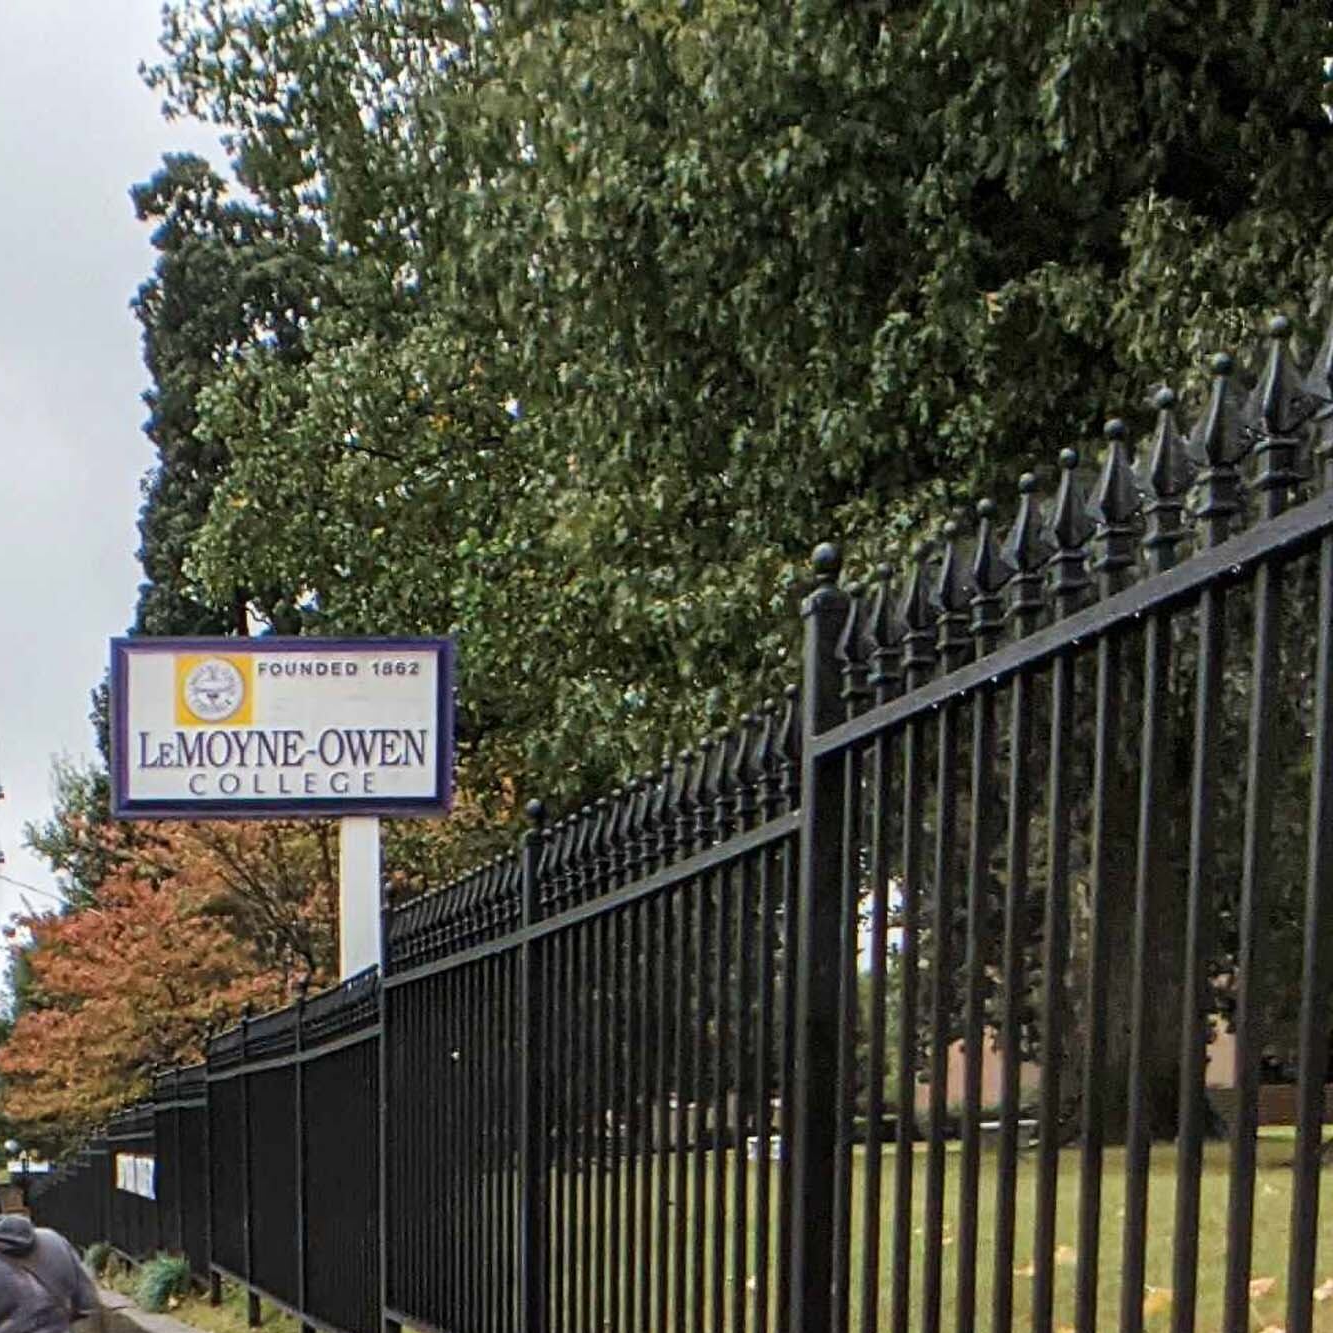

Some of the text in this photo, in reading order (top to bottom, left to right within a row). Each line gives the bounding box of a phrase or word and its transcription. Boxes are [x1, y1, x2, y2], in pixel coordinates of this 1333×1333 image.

[257, 661, 421, 677] FOUNDED 1862
[188, 771, 377, 796] COLLEGE
